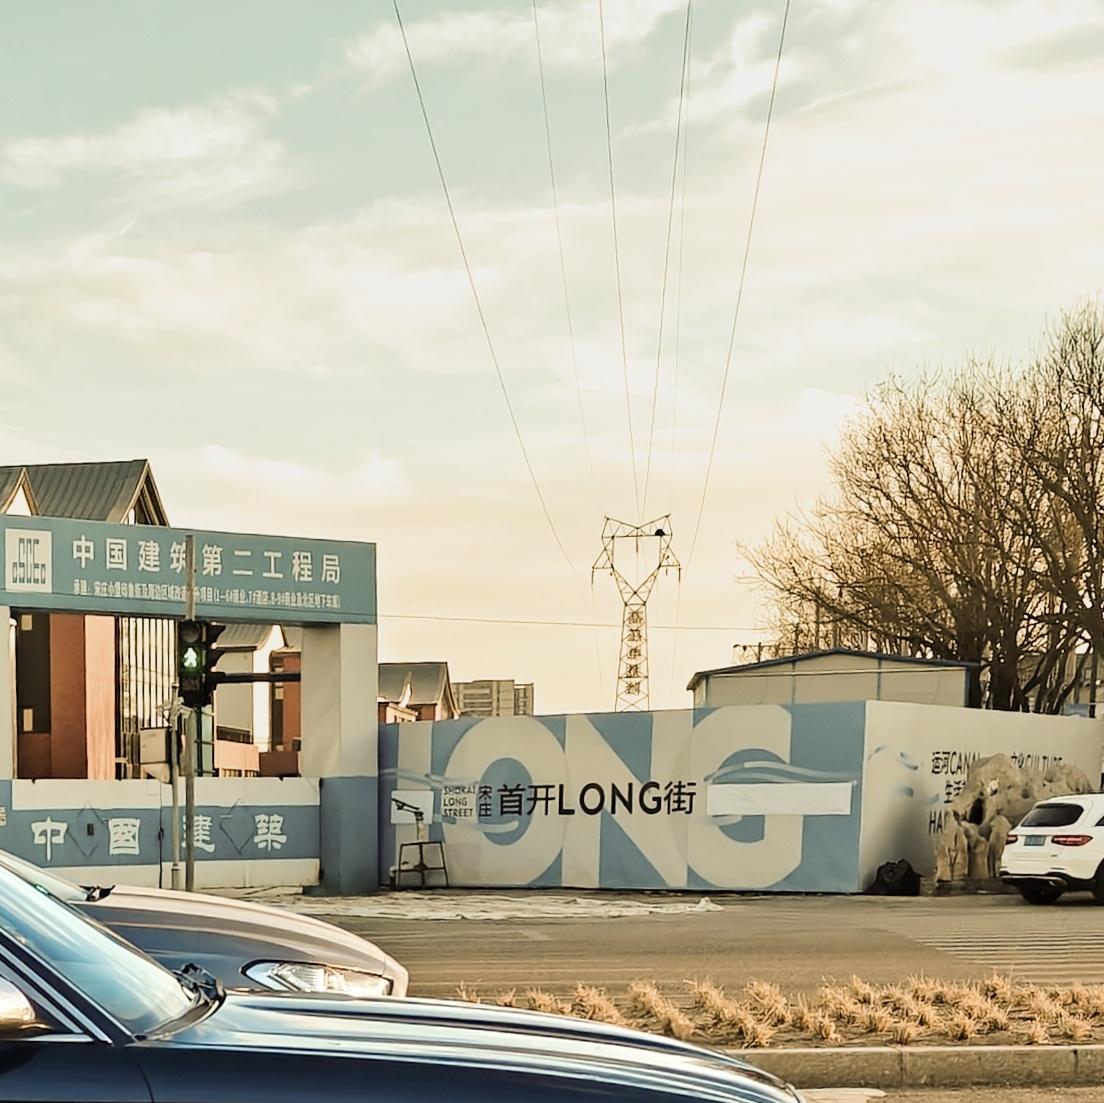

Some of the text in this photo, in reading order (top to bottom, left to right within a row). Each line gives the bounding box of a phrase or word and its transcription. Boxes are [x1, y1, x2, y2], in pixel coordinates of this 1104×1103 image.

[72, 534, 341, 584] 中国建筑第二工程局
[443, 797, 468, 807] LONG
[443, 808, 474, 817] STREET
